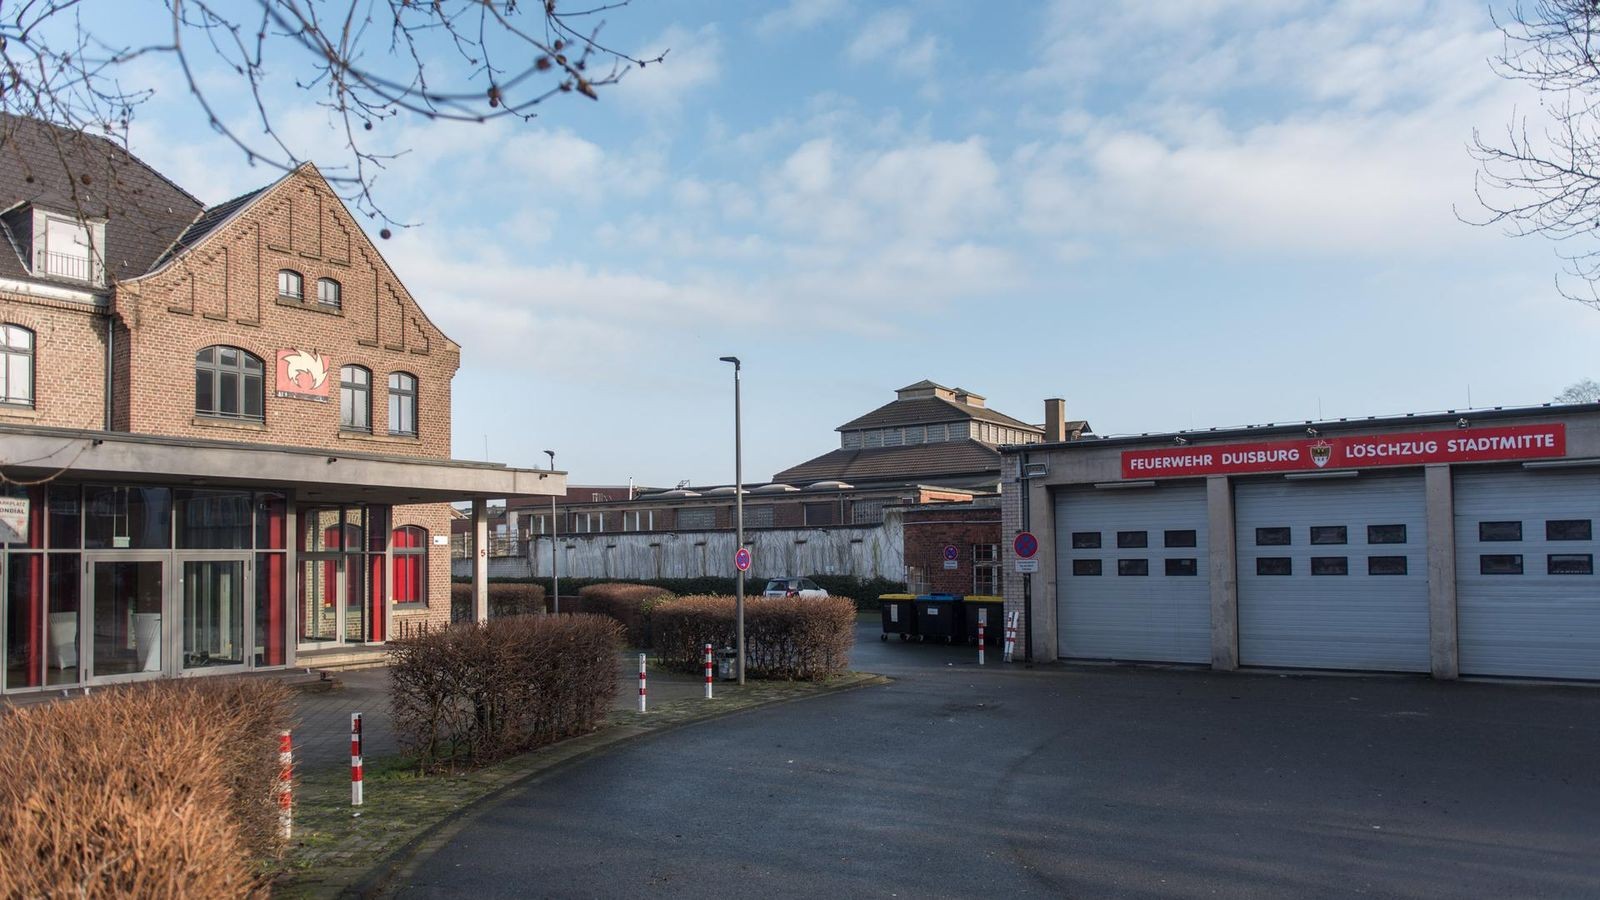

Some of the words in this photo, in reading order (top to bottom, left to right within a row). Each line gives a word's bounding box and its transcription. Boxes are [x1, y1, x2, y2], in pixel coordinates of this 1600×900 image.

[1131, 454, 1213, 470] FEUERWEHR
[1222, 449, 1300, 465] DUISBURG
[1346, 442, 1438, 458] LÖSCHZUG
[1447, 434, 1554, 453] STADTMITTE
[480, 549, 486, 557] 5
